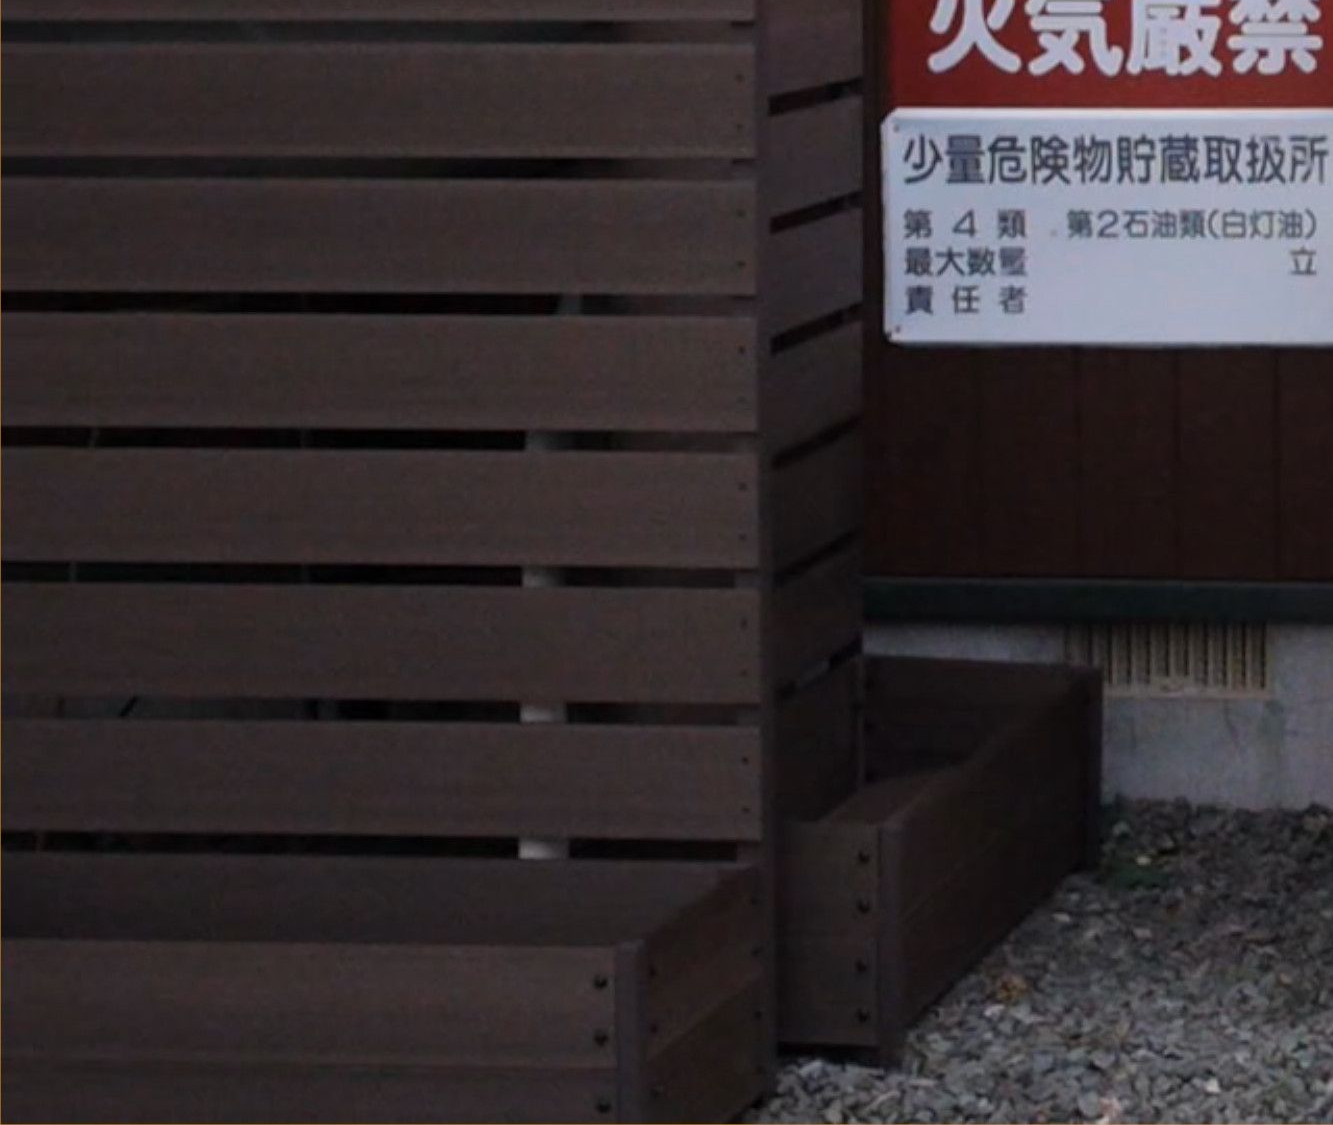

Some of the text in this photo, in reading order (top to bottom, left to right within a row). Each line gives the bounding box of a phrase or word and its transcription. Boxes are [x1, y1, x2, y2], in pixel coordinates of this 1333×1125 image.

[903, 132, 1329, 185] 少量危険物貯蔵取扱所
[1288, 246, 1318, 276] 立
